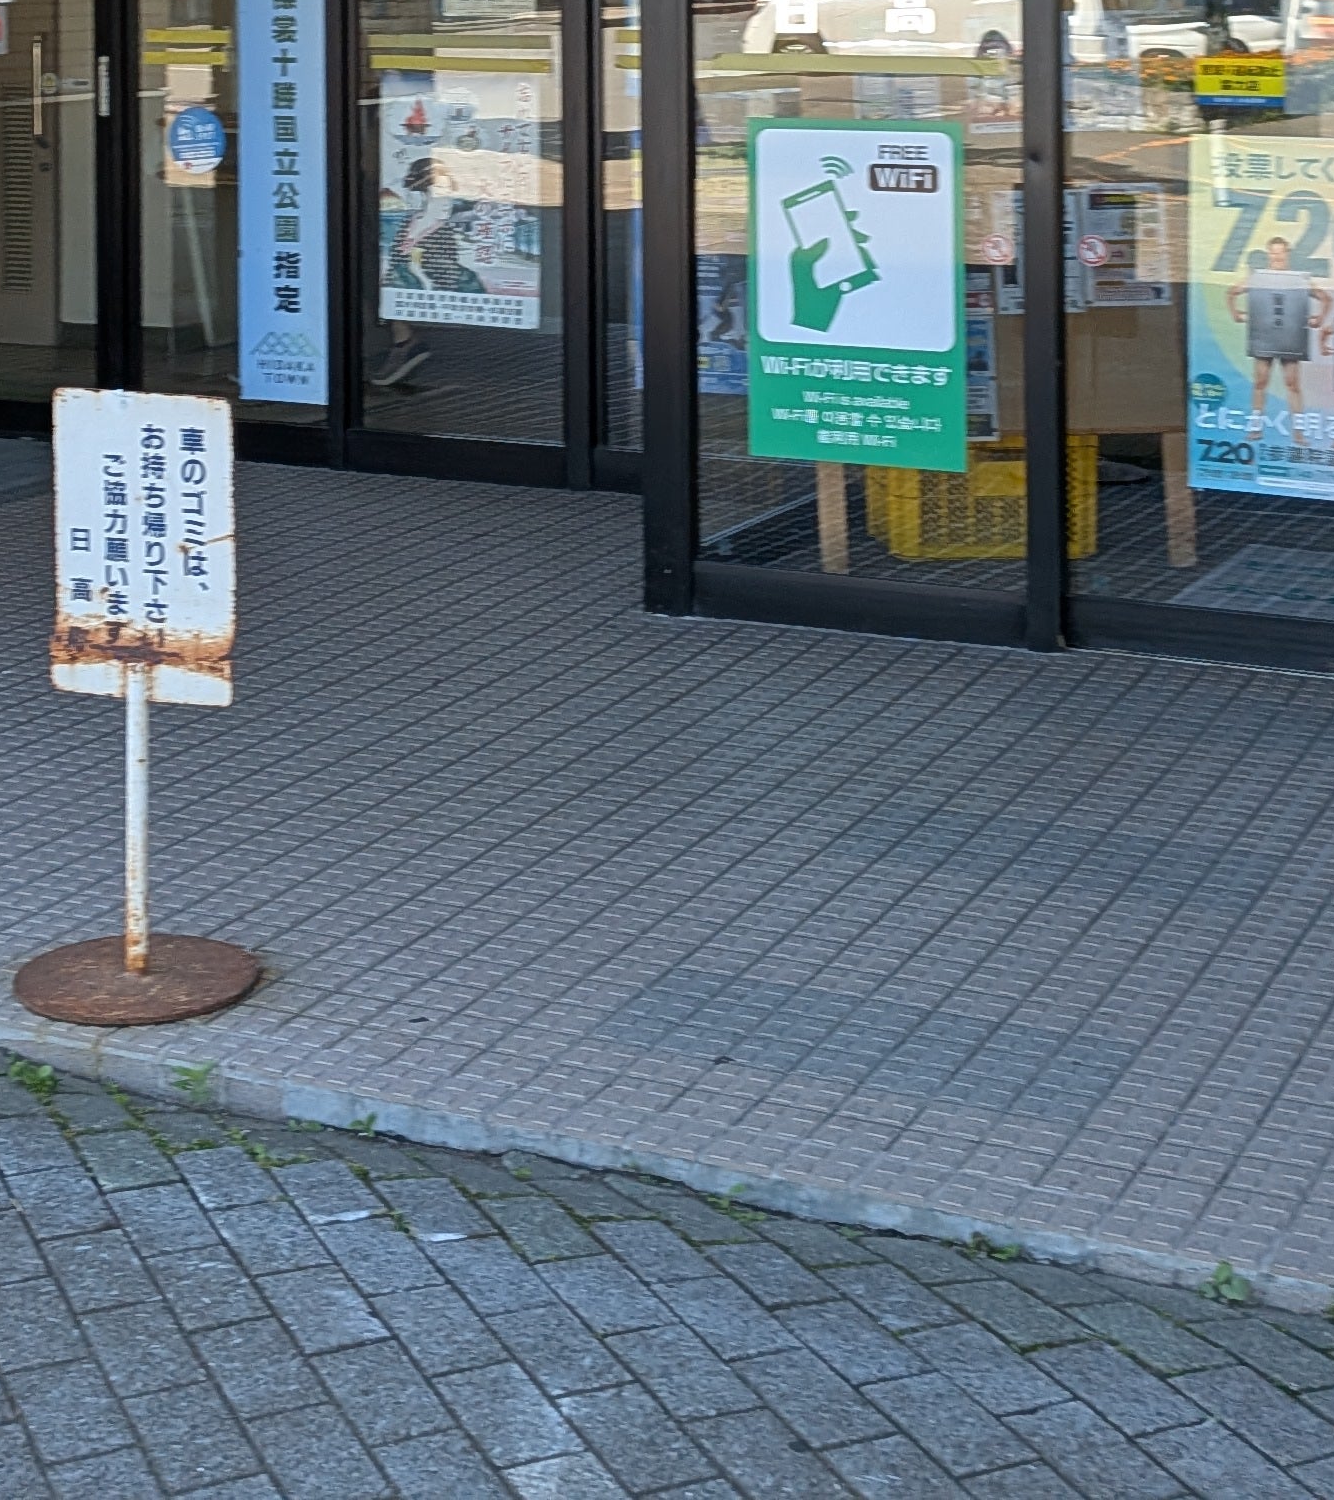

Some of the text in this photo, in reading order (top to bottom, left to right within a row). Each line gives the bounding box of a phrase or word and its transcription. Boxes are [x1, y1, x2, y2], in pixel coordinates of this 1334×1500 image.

[877, 144, 930, 161] FREE
[873, 166, 934, 190] WiFi
[759, 355, 954, 387] Wi-Fiが利用できます
